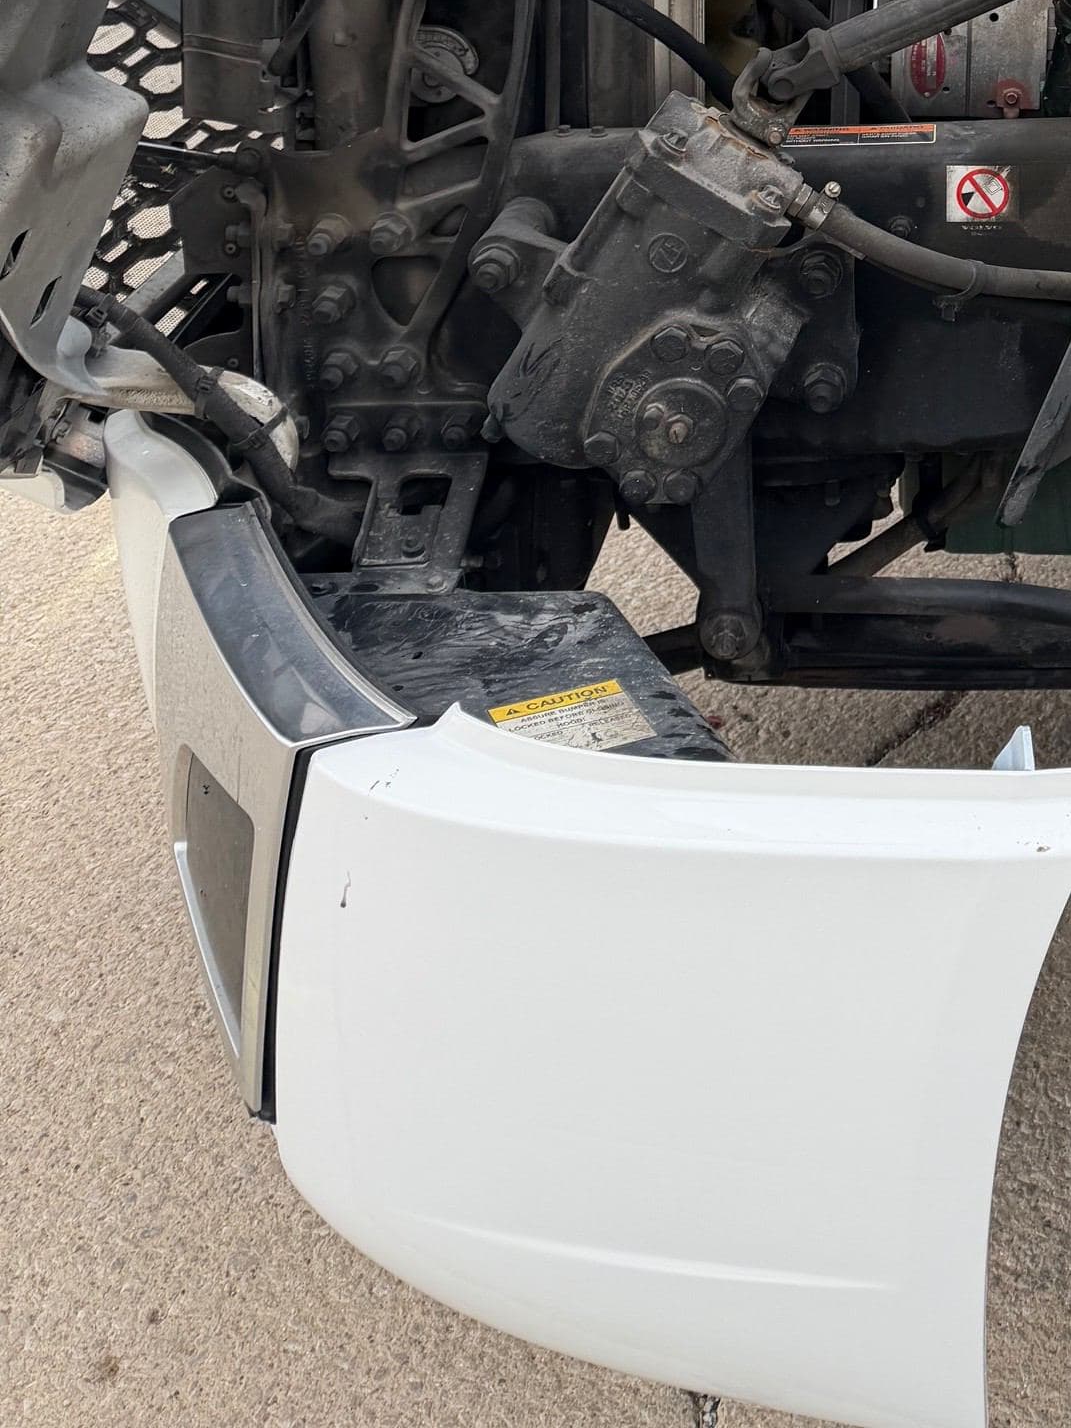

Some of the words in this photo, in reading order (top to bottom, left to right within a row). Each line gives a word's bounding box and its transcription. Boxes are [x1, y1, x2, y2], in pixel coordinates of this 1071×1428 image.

[526, 685, 608, 711] CAUTION
[508, 720, 546, 732] LOCKED
[548, 711, 584, 723] BEFORE
[520, 711, 557, 723] ASSURE
[558, 701, 597, 714] BUMPER
[533, 731, 564, 741] OCKED
